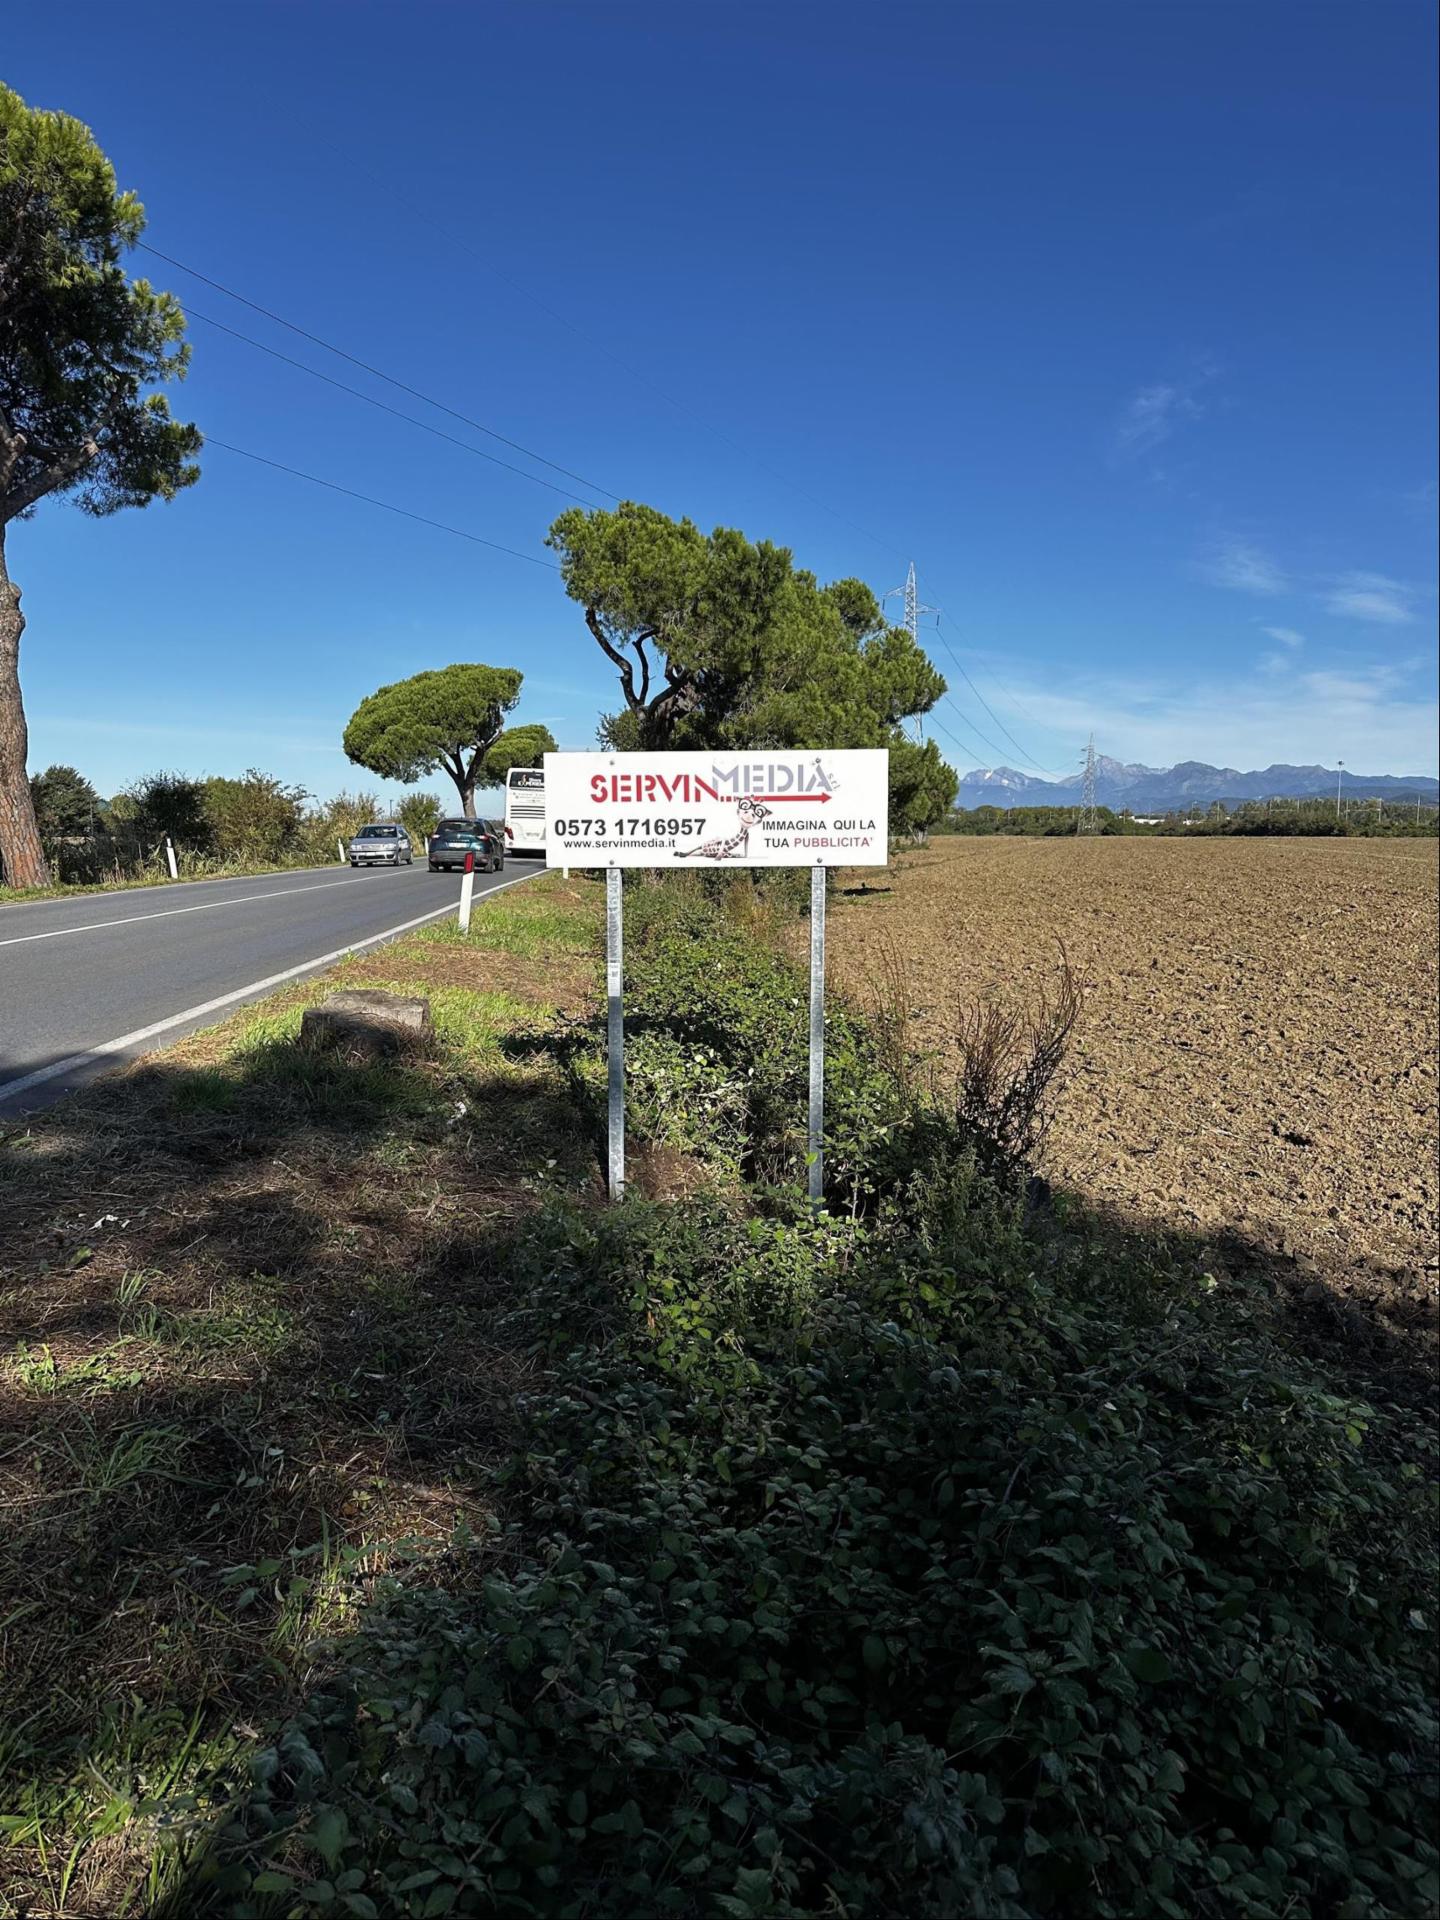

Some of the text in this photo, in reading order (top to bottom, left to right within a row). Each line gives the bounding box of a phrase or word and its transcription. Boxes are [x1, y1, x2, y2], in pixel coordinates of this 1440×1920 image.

[590, 774, 718, 803] SERVIN
[711, 764, 833, 793] MEDIA
[554, 818, 706, 836] 0573 1716957
[762, 820, 876, 831] IMMAGINA QUI LA
[563, 838, 676, 848] www.servinmedia.it
[764, 838, 790, 848] TUA
